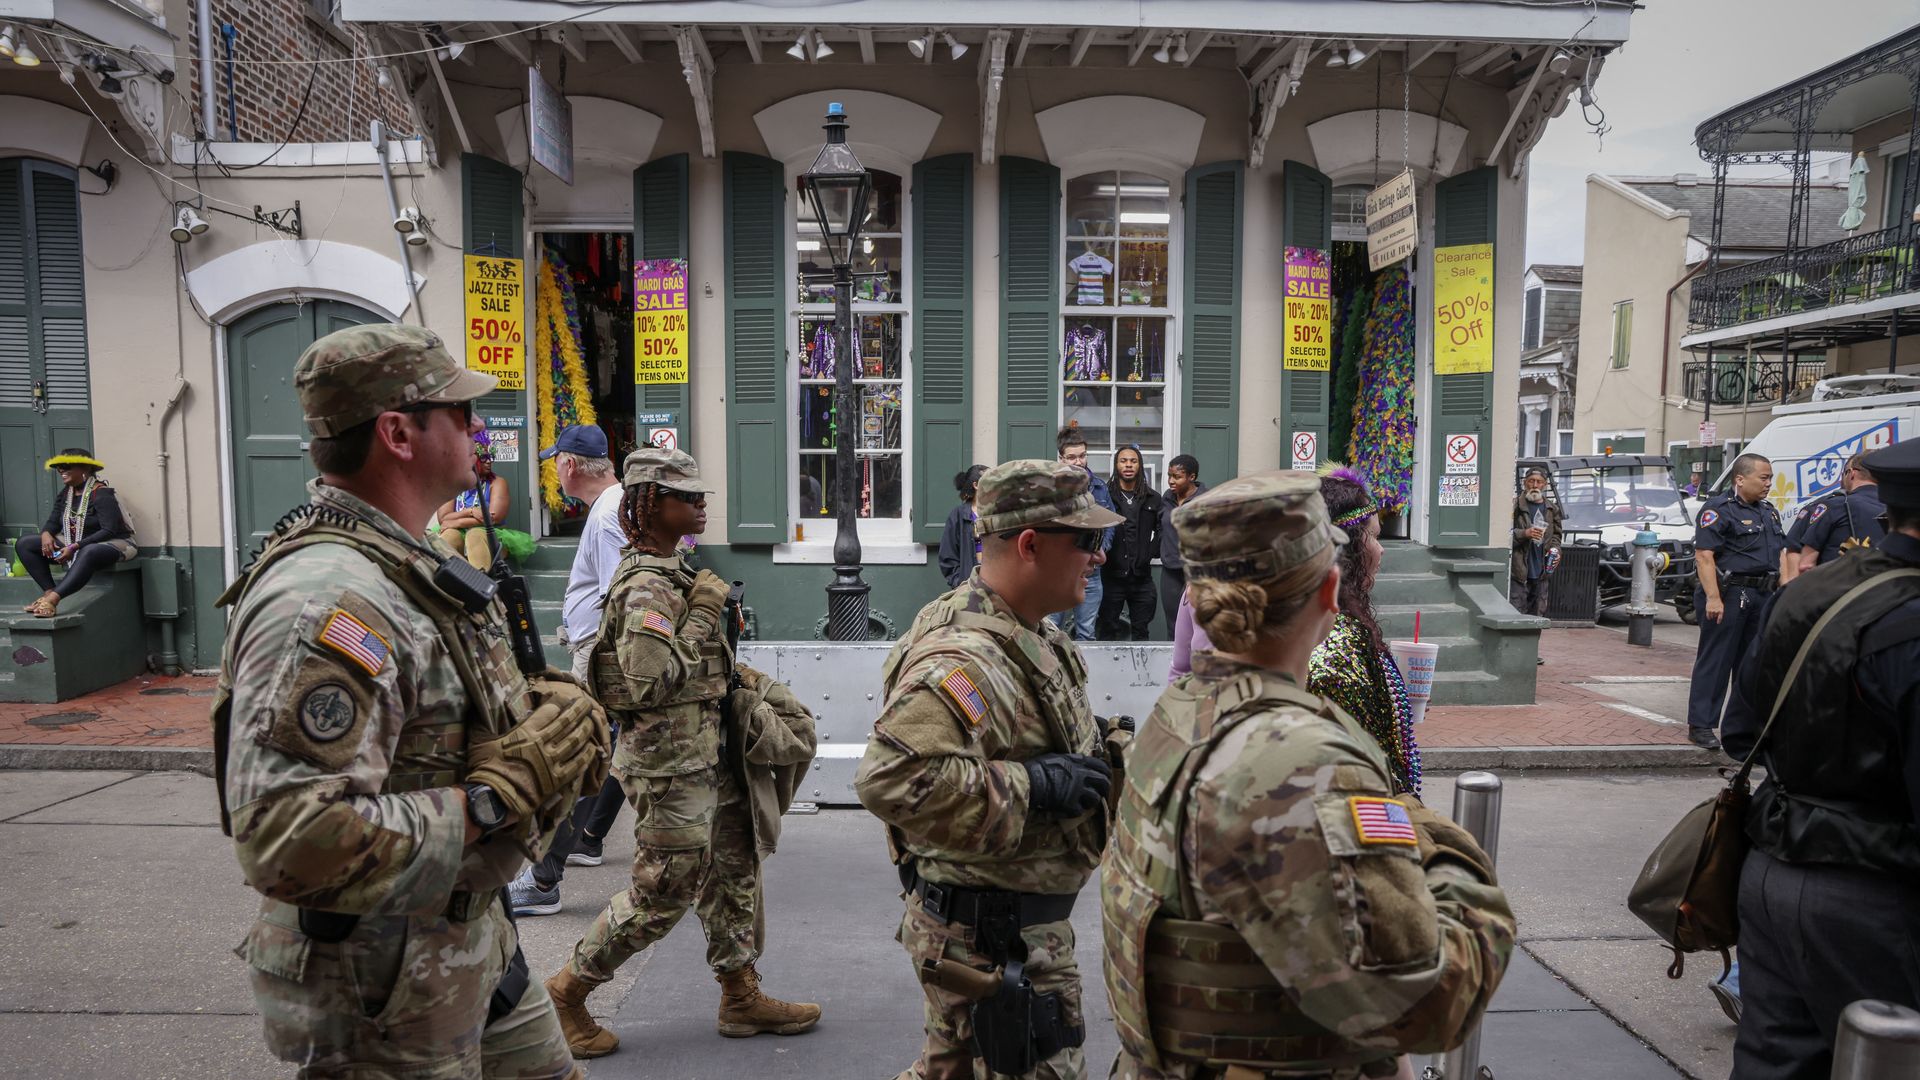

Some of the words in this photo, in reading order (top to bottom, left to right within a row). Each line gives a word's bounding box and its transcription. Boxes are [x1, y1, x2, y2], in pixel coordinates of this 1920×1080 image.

[1436, 251, 1492, 264] Clearance
[1288, 264, 1310, 279] MARDI
[1312, 266, 1328, 280] GRAS
[1450, 266, 1476, 278] Sale
[469, 281, 494, 294] JAZZ
[496, 283, 520, 297] FEST
[637, 278, 660, 292] MARDI
[662, 276, 684, 290] GRAS
[1288, 280, 1328, 298] SALE
[481, 298, 510, 312] SALE
[637, 292, 685, 310] SALE
[1438, 292, 1489, 325] 50%
[1288, 302, 1306, 319] 10%
[1310, 304, 1328, 320] 20%
[470, 318, 521, 343] 50%
[637, 316, 656, 333] 10%
[662, 315, 685, 332] 20%
[1450, 318, 1484, 346] Off
[1294, 325, 1323, 344] 50%
[644, 338, 678, 356] 50%
[1290, 346, 1326, 356] SELECTED
[478, 346, 514, 365] OFF
[1286, 358, 1308, 367] ITEMS
[1310, 359, 1328, 368] ONLY
[640, 360, 682, 370] SELECTED
[500, 380, 523, 388] ONLY
[637, 372, 662, 382] ITEMS
[664, 372, 686, 381] ONLY
[489, 432, 515, 440] EADS
[1443, 478, 1476, 486] BEADS
[1408, 684, 1430, 692] SLUS
